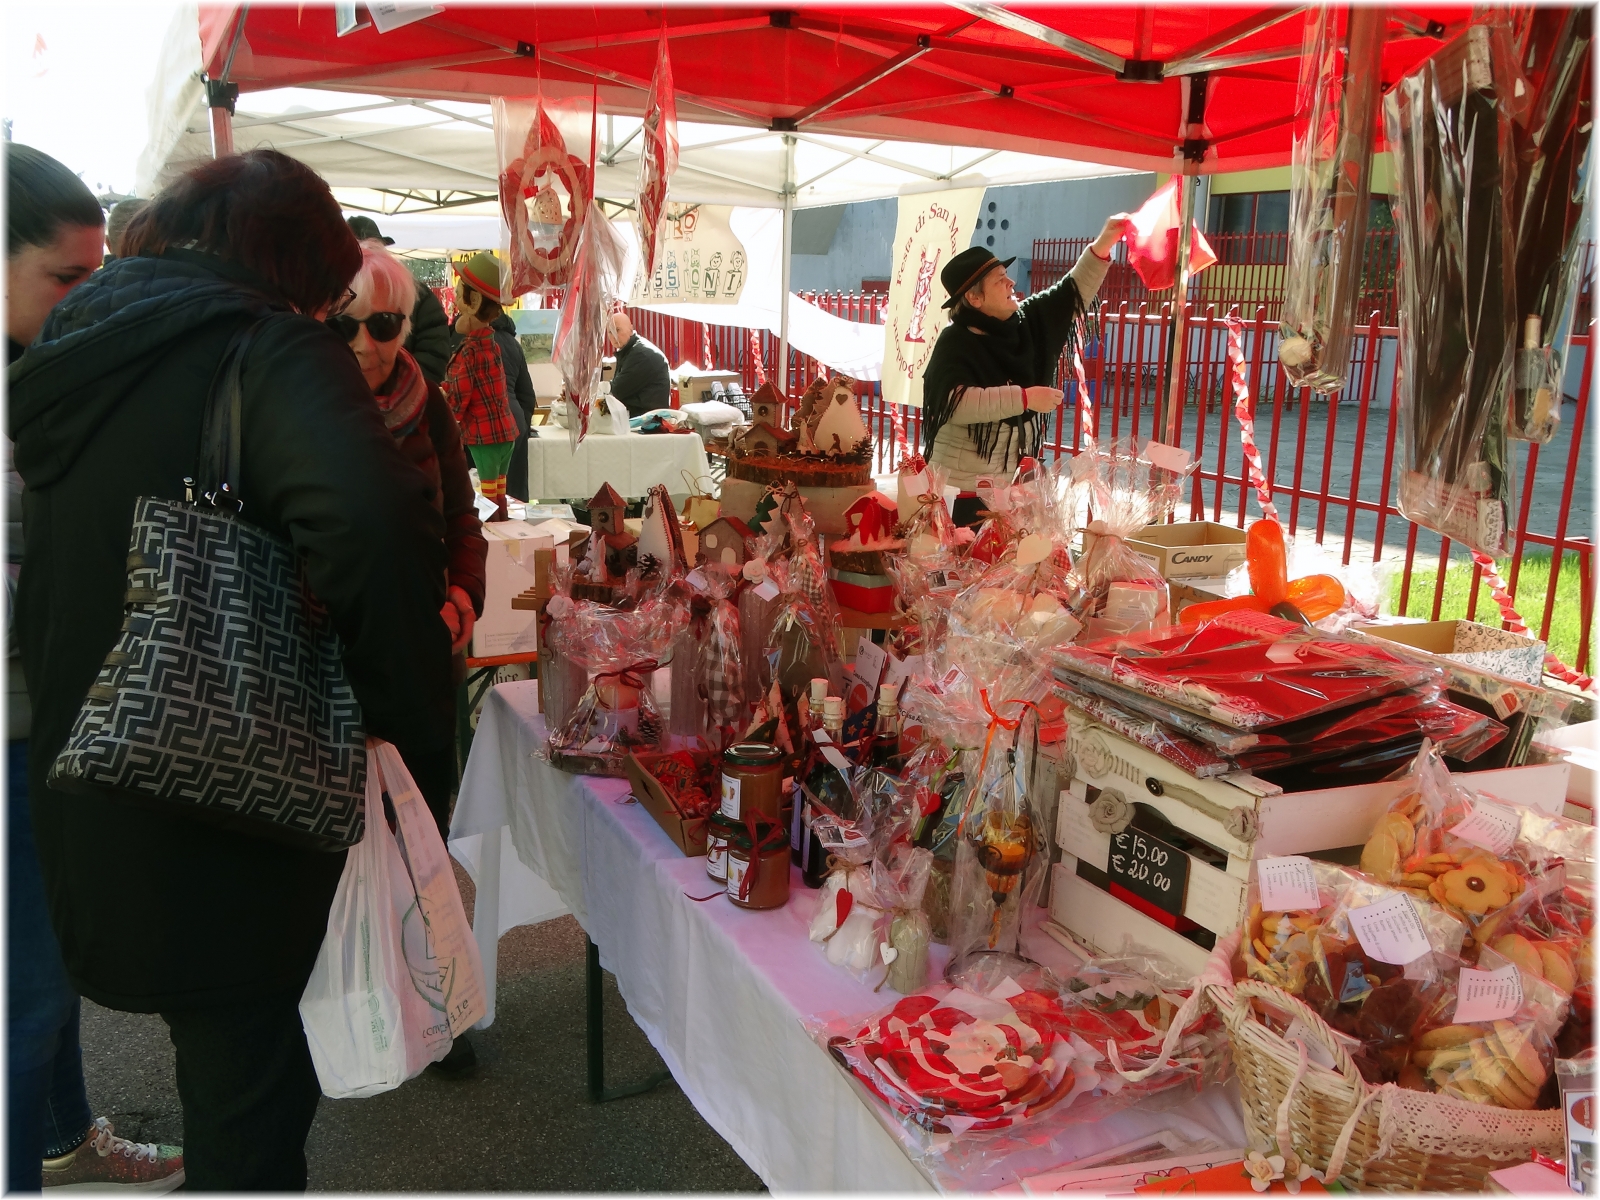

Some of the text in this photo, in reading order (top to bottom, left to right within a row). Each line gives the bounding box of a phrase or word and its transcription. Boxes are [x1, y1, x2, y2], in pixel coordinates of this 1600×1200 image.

[915, 211, 925, 233] di
[929, 203, 949, 222] San
[1115, 833, 1169, 867] € 15.00
[1111, 854, 1171, 892] € 20.00
